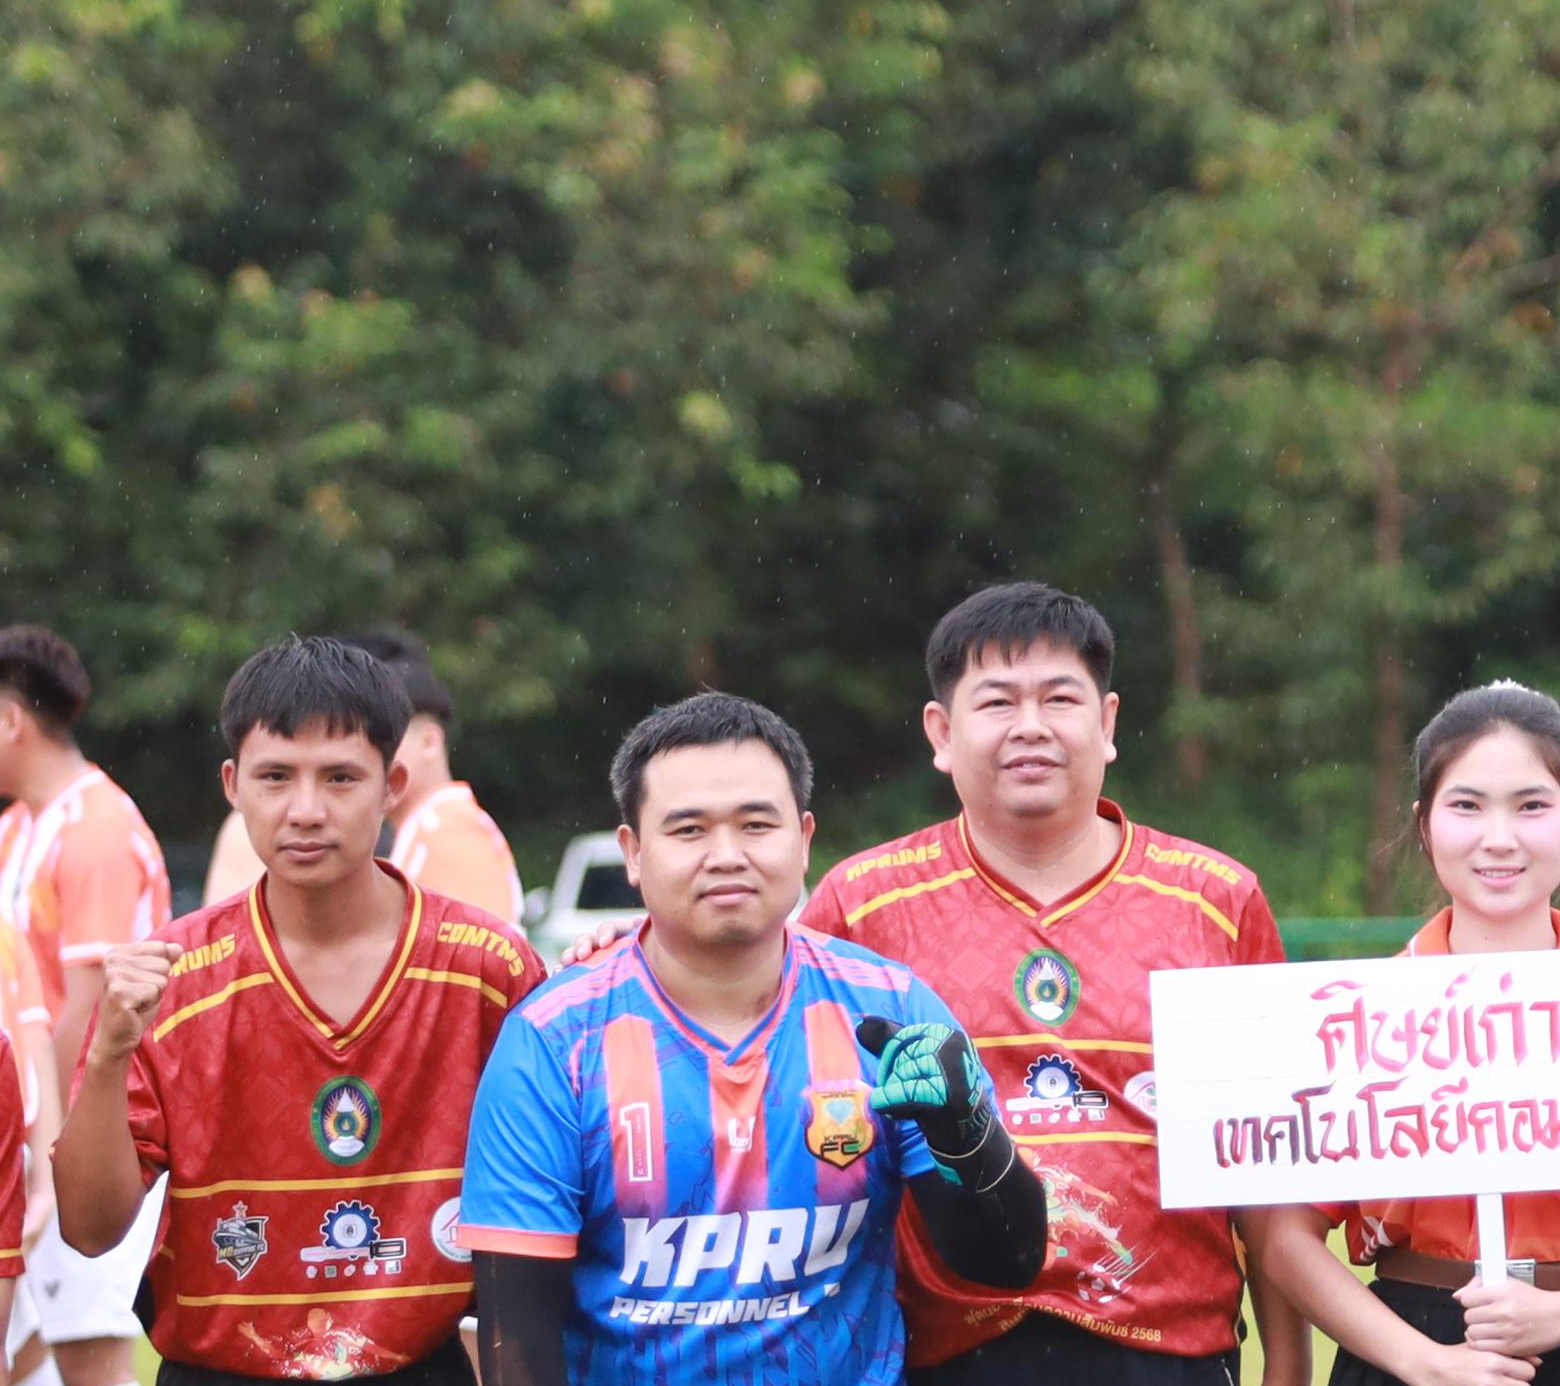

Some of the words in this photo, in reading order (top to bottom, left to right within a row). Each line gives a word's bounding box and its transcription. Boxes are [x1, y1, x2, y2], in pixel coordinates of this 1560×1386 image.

[1144, 843, 1242, 885] COMTMS
[620, 1103, 653, 1182] 1
[620, 1199, 870, 1288] KPRU
[609, 1291, 810, 1325] PERSONNEL
[1130, 1326, 1162, 1343] 2568
